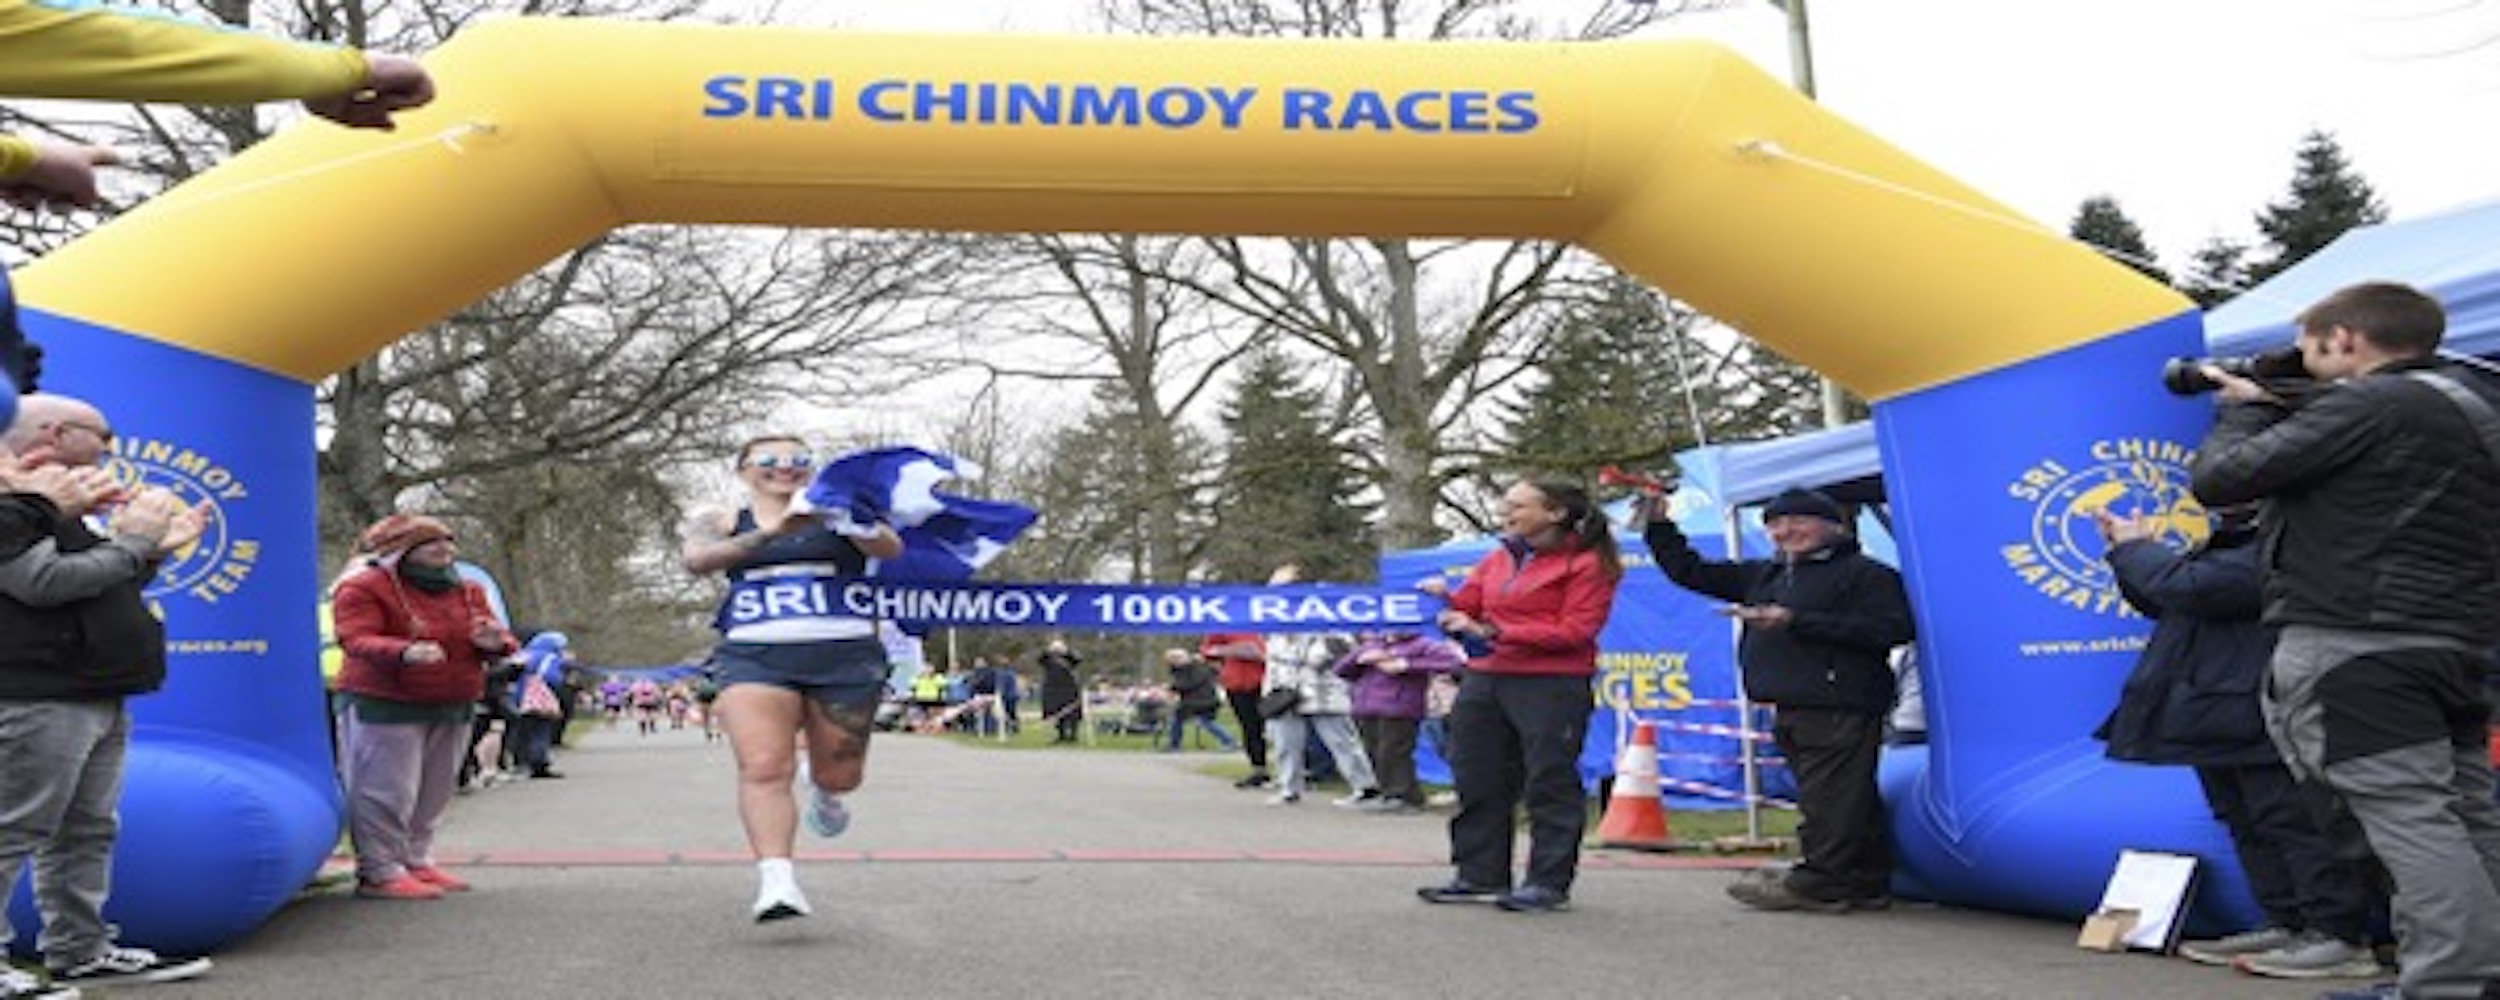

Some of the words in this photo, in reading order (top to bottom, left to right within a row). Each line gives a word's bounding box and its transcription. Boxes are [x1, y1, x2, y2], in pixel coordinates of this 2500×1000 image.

[702, 76, 833, 120] SRI
[858, 81, 1257, 128] CHINMOY
[1282, 88, 1539, 133] RACES
[2008, 459, 2068, 501] SRI
[191, 540, 260, 603] TEAM
[732, 582, 828, 621] SRI
[844, 582, 1068, 623] CHINMOY
[1092, 594, 1230, 623] 100K
[1249, 594, 1422, 623] RACE
